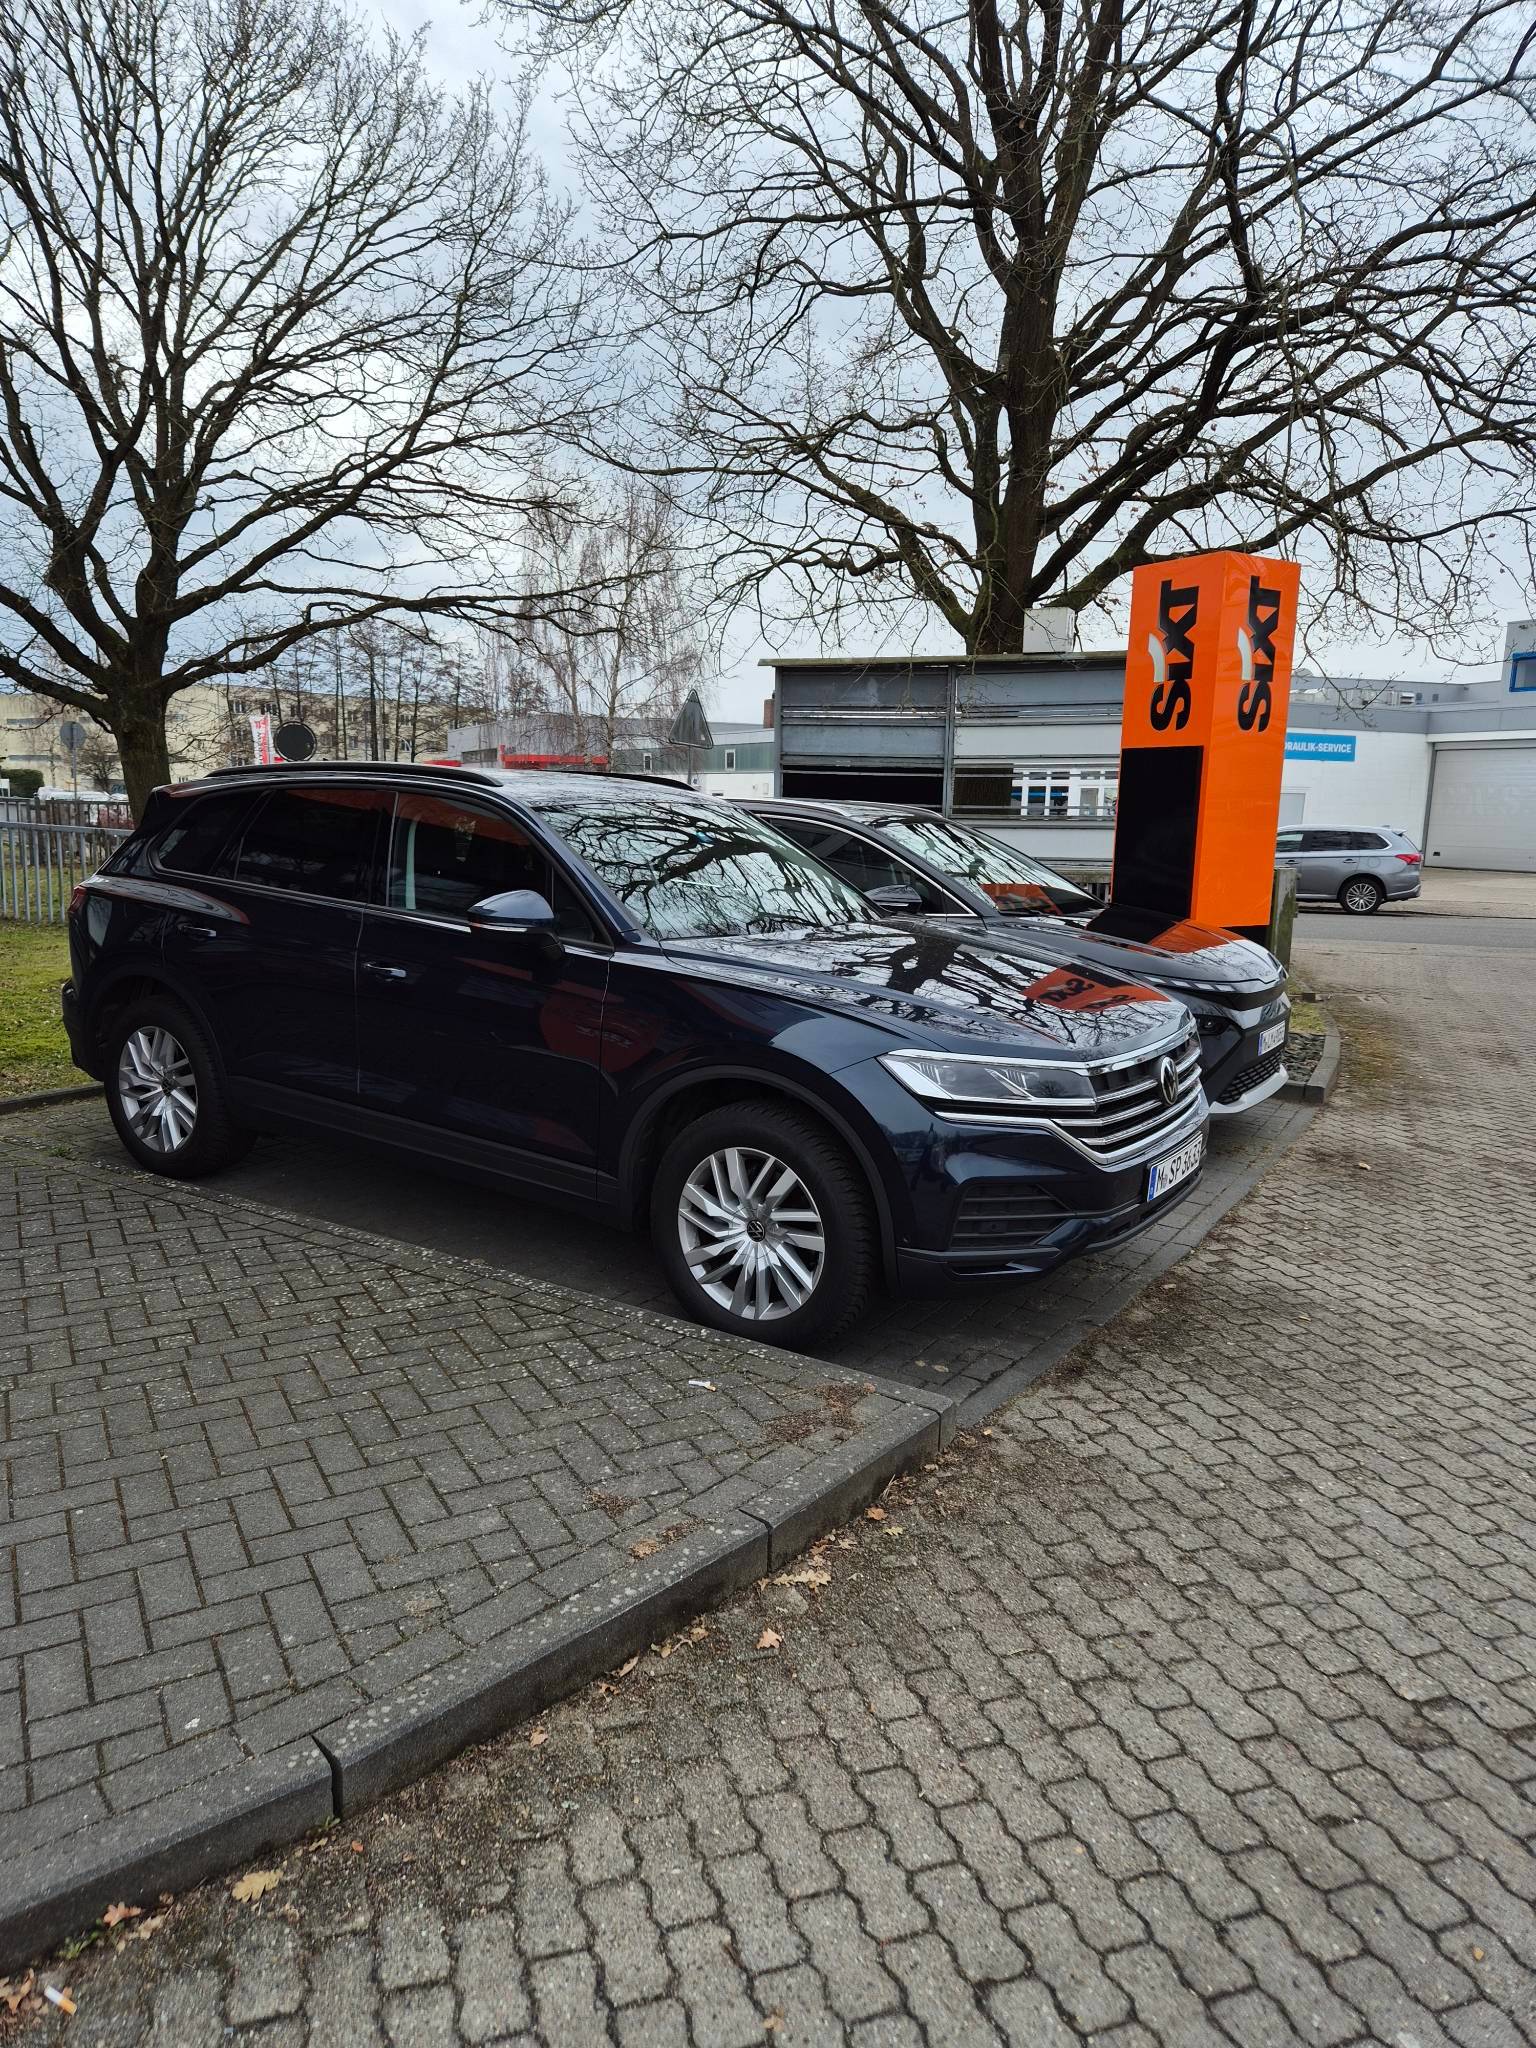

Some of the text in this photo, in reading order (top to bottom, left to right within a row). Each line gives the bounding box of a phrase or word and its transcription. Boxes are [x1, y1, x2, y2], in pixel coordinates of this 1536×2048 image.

[1148, 579, 1200, 731] SIXT
[1237, 575, 1281, 732] SIXT
[1168, 1155, 1182, 1185] SP
